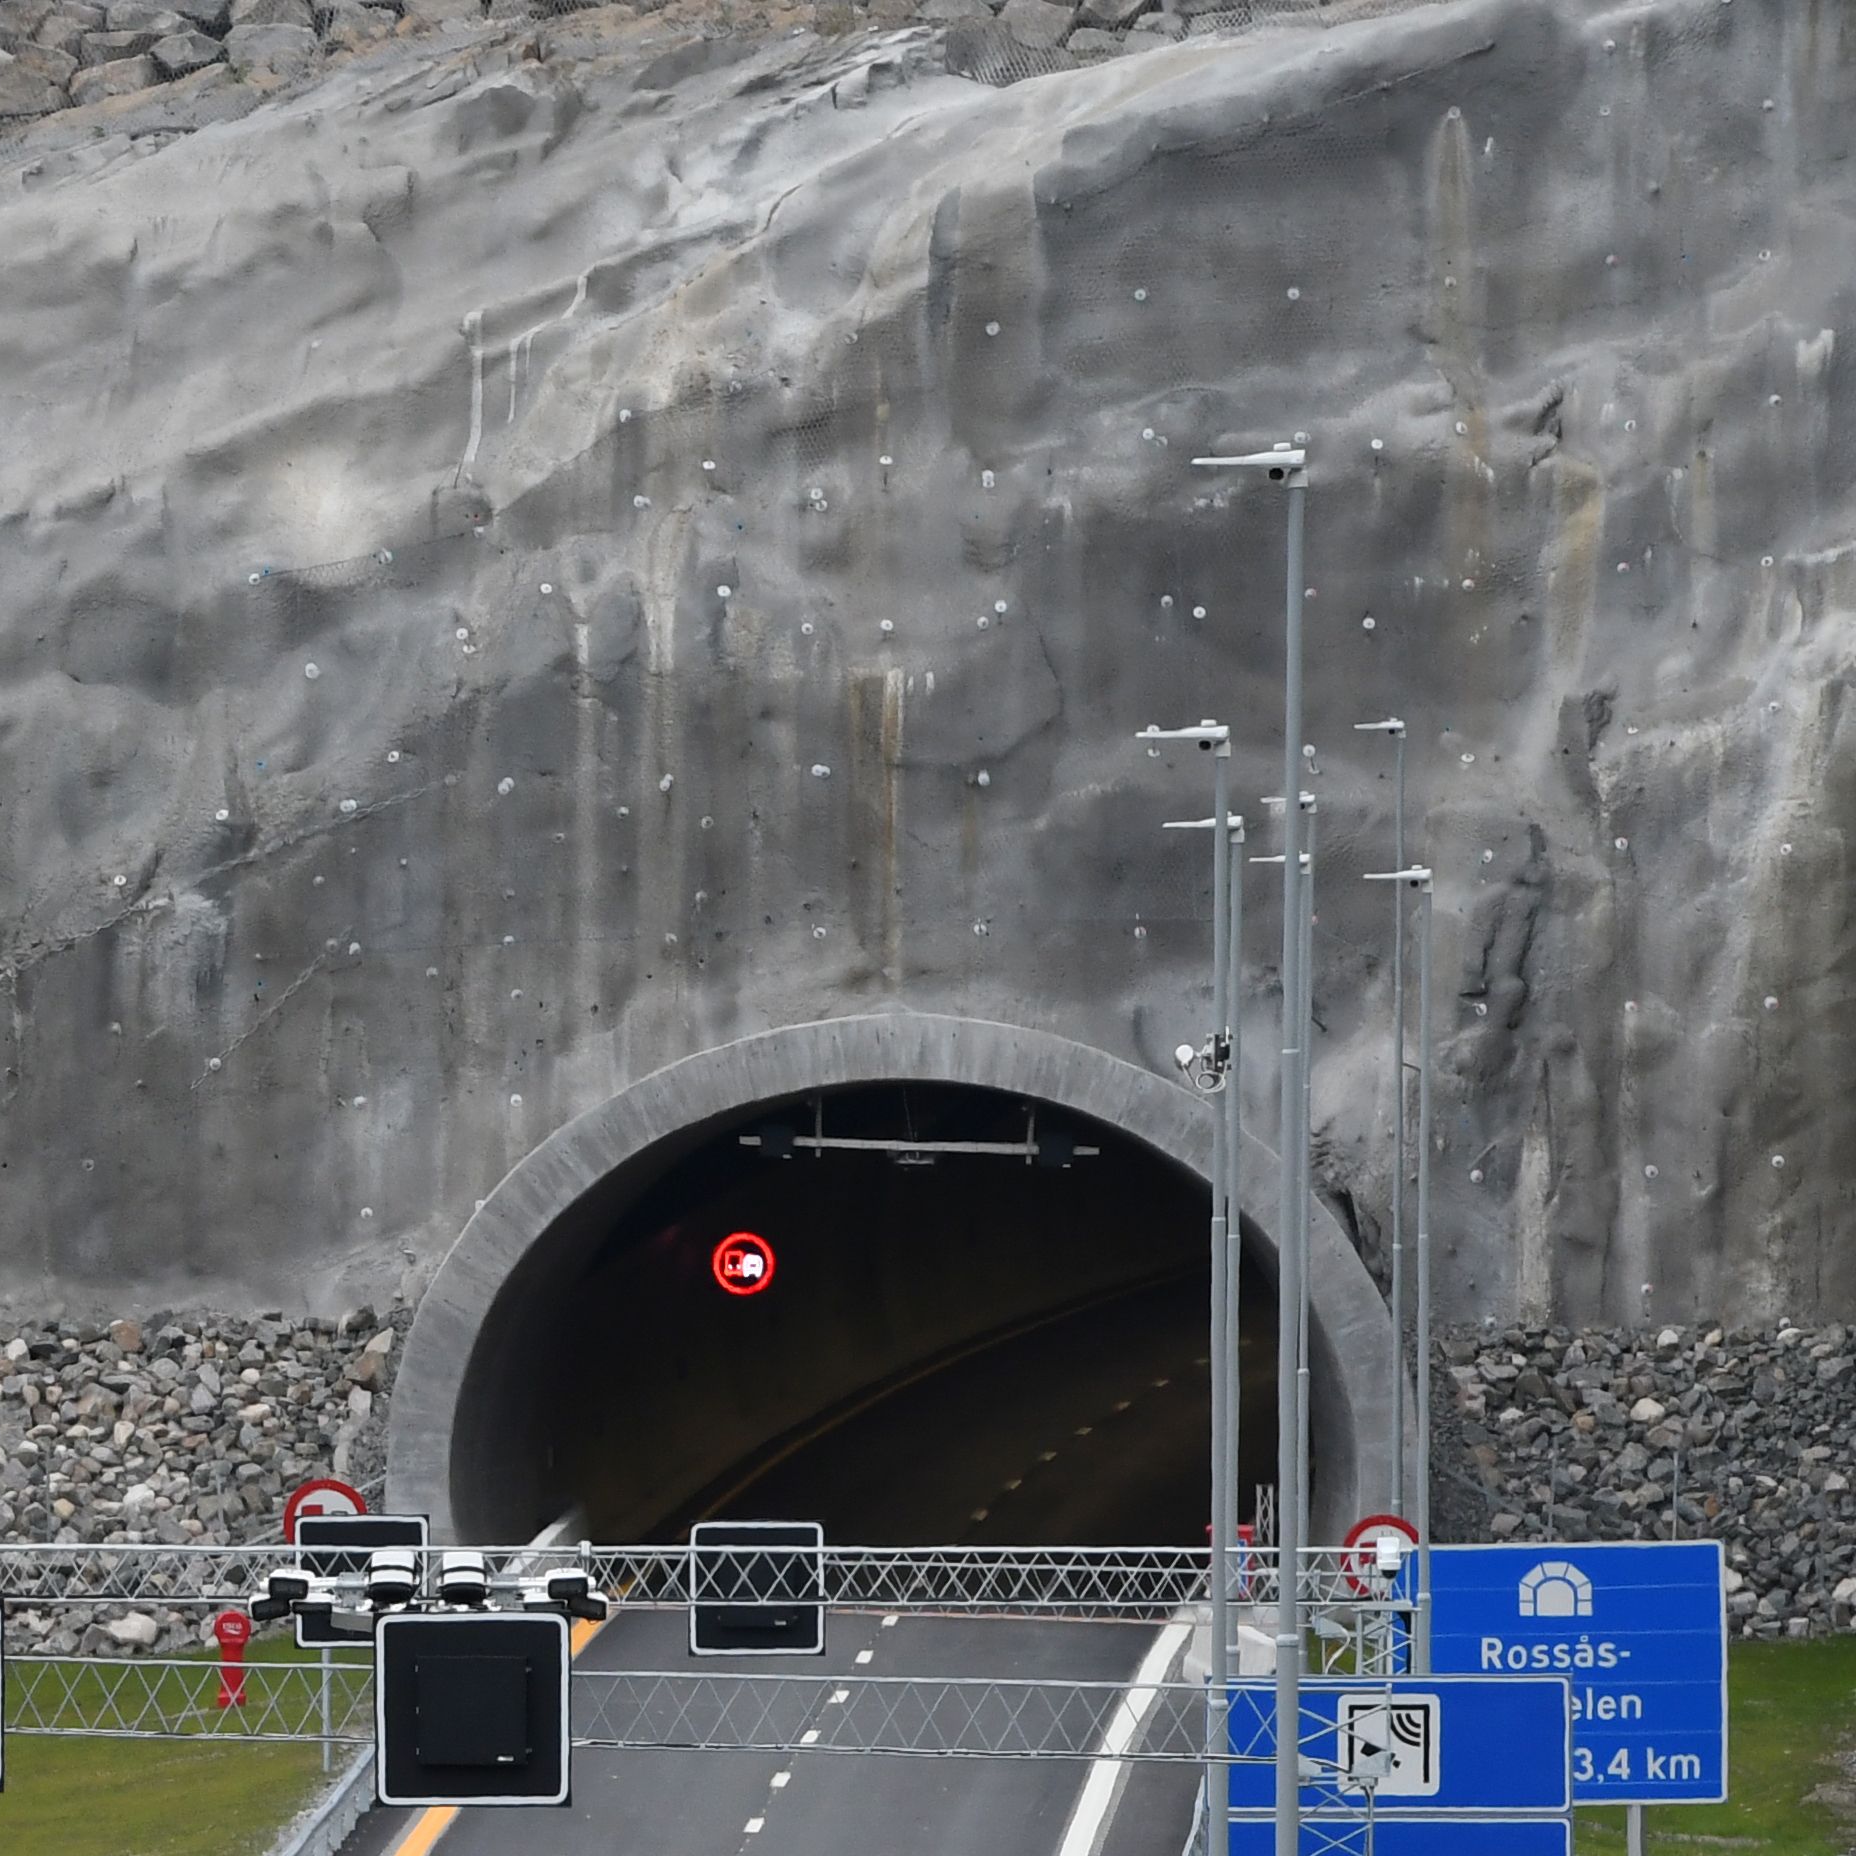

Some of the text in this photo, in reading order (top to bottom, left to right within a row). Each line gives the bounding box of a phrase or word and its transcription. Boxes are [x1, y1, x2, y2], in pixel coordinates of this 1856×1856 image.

[1480, 1634, 1631, 1670] Rossås-
[1573, 1746, 1701, 1784] 3,4 km
